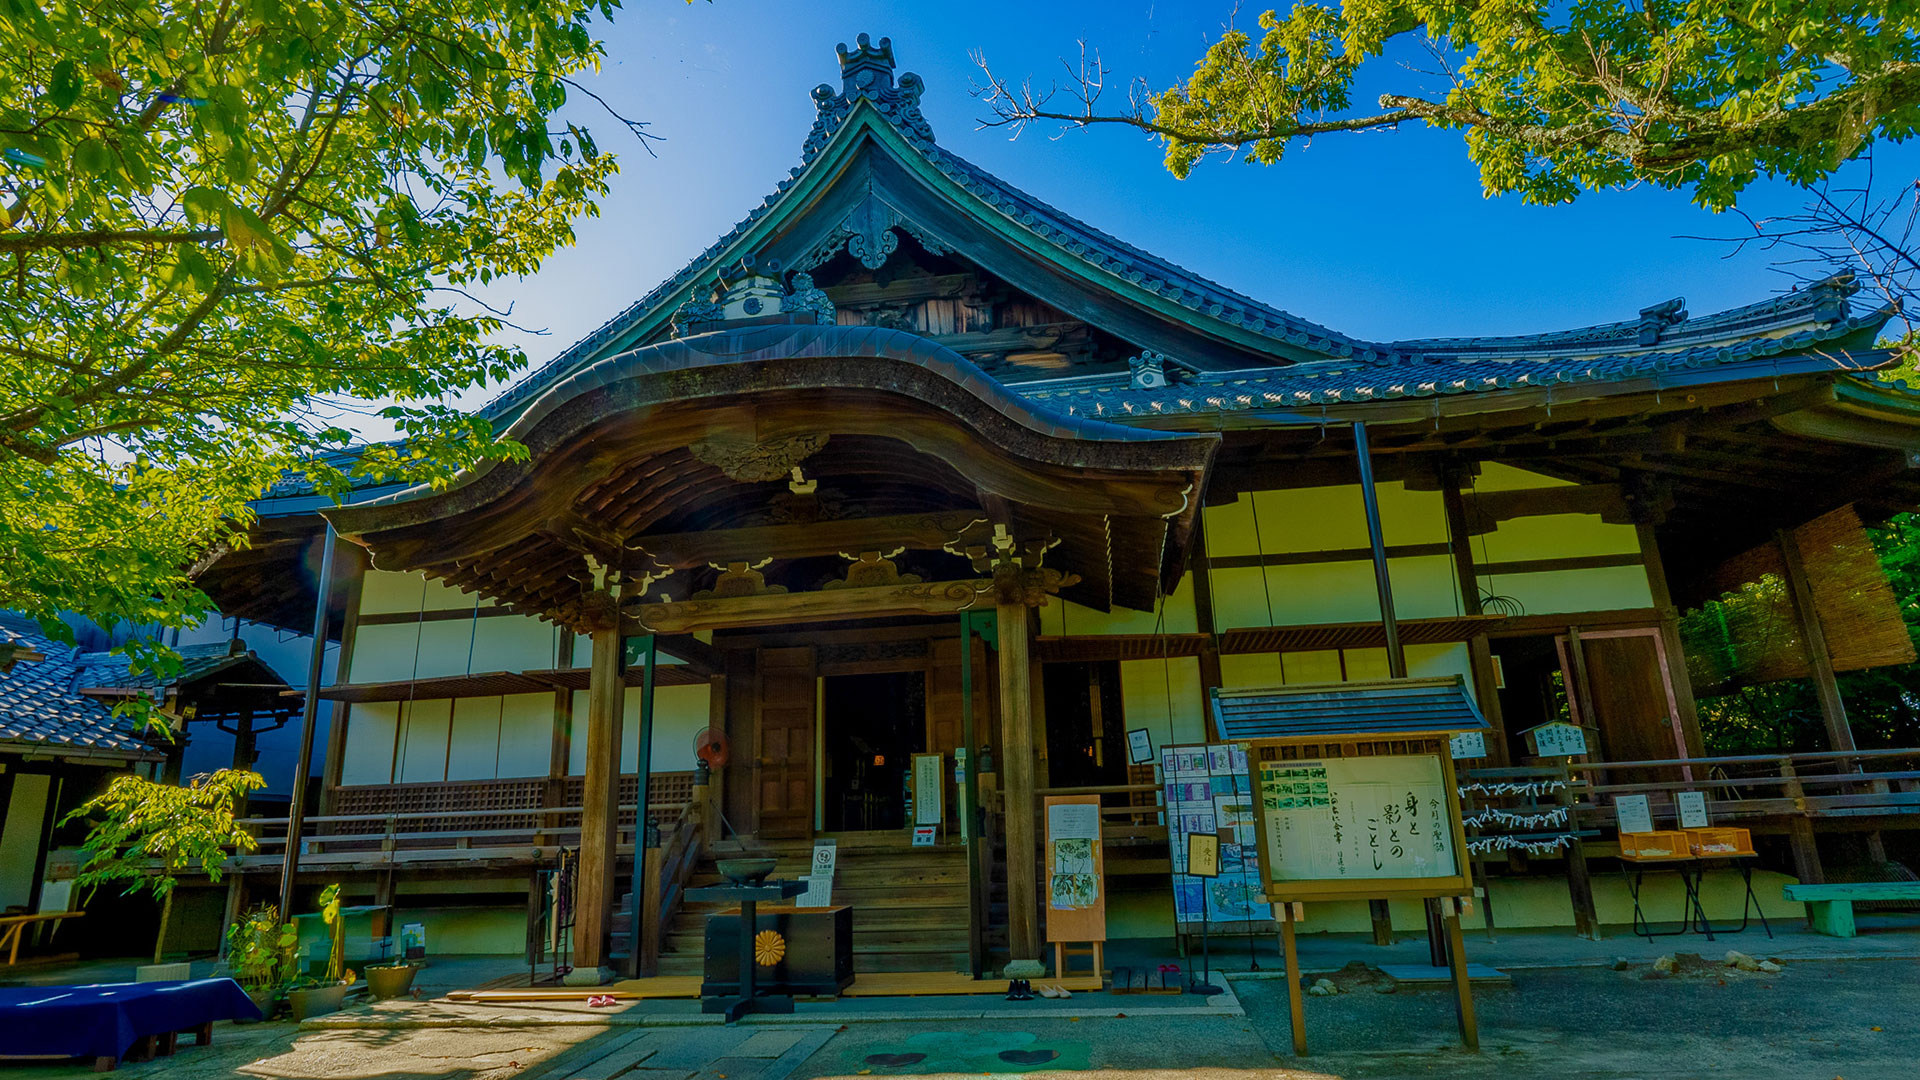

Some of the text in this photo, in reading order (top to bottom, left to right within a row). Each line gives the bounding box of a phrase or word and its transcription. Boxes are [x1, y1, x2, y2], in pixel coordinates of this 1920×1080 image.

[1382, 804, 1404, 858] 影との
[1404, 791, 1420, 835] 身と
[1428, 798, 1445, 852] 今月の聖語
[1367, 818, 1383, 871] ごとし
